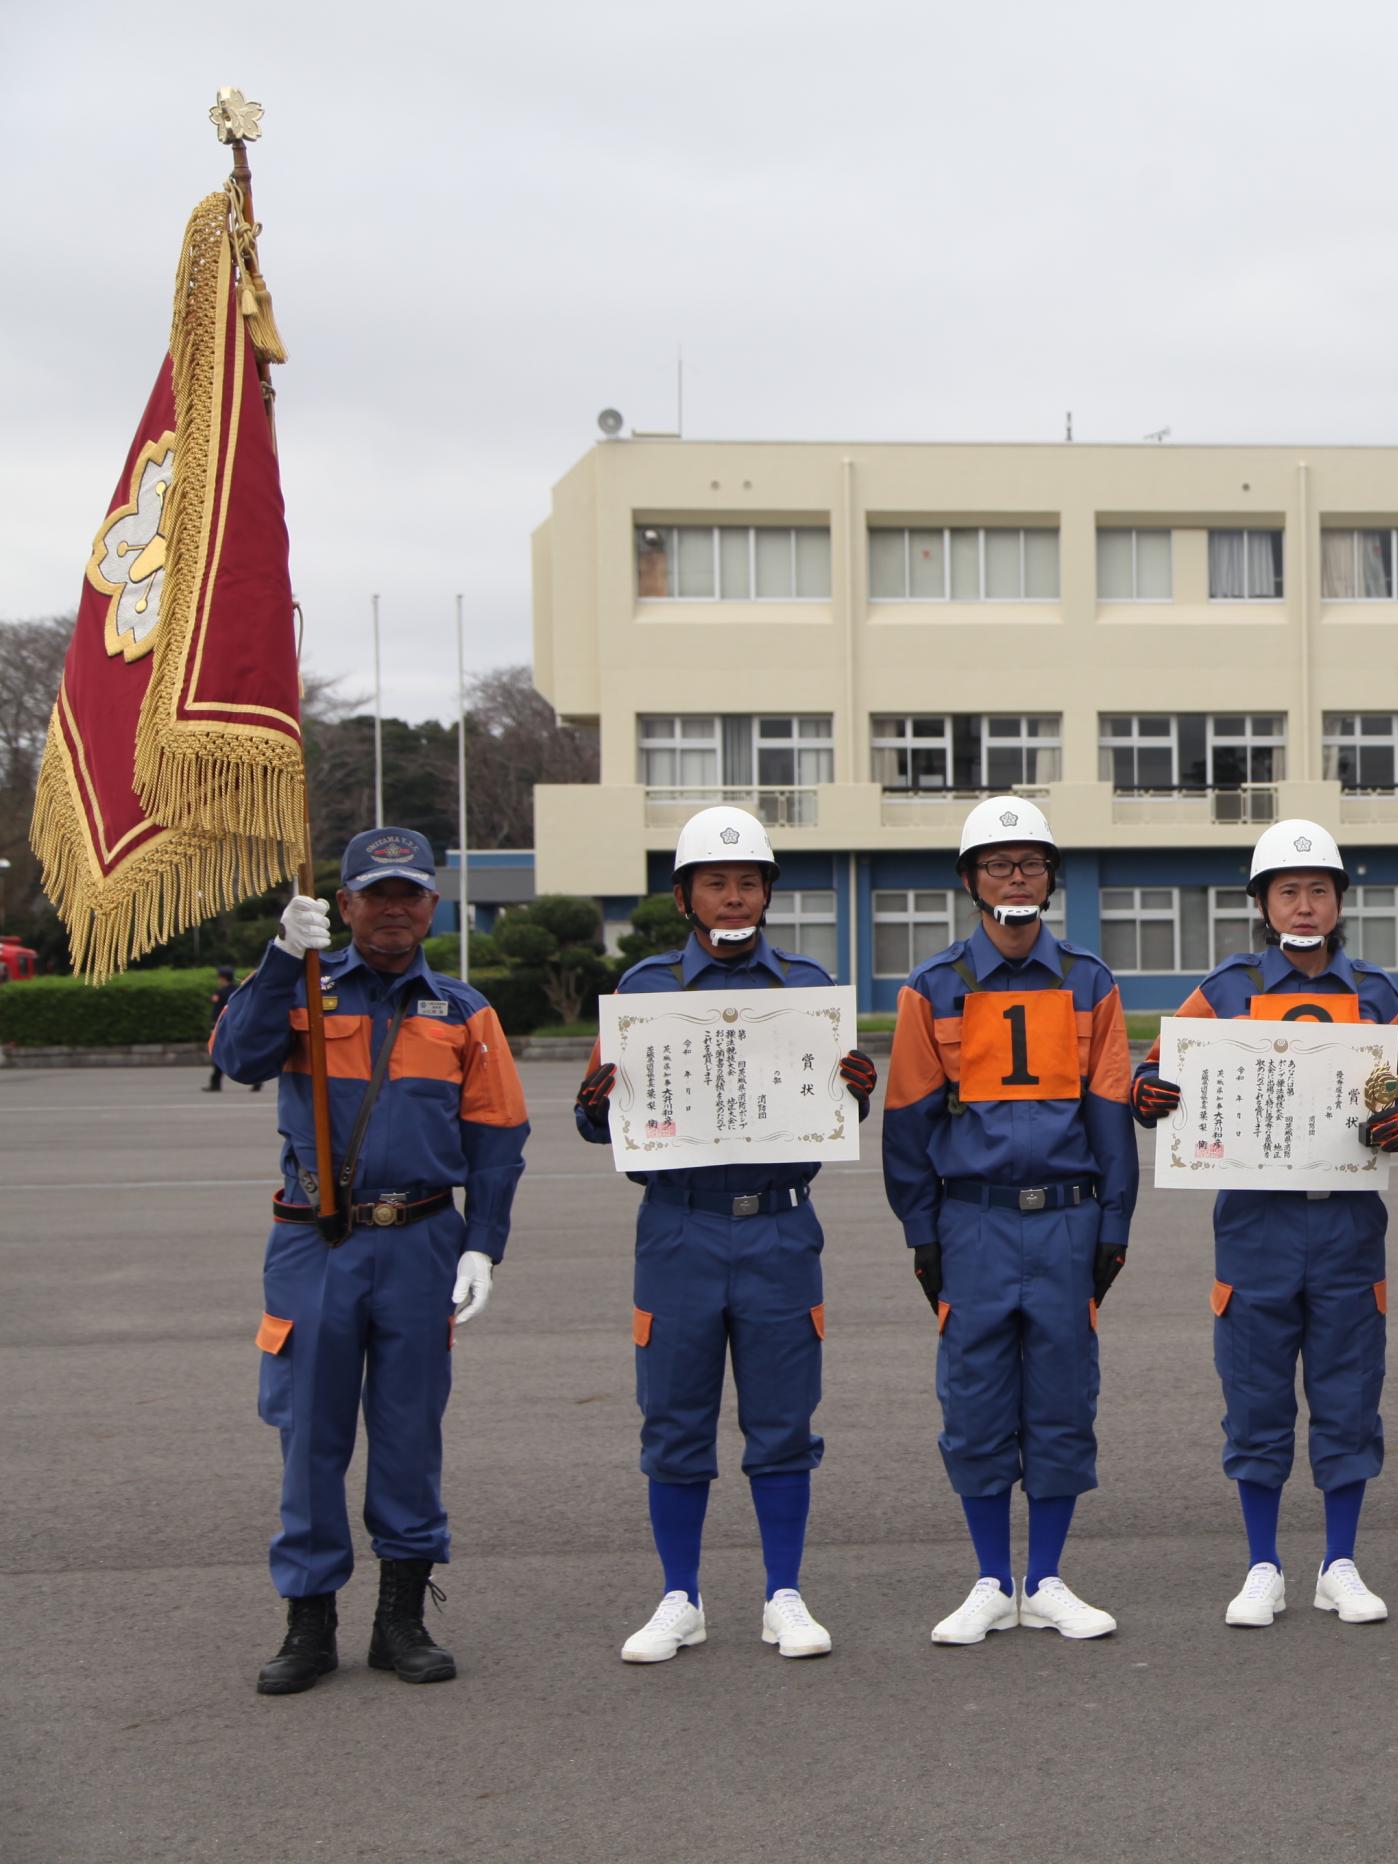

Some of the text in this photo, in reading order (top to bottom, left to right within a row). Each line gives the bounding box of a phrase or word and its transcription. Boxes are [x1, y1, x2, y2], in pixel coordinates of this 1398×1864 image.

[1001, 1005, 1040, 1085] 1
[800, 1053, 815, 1096] 賞状
[1345, 1088, 1360, 1128] 賞状
